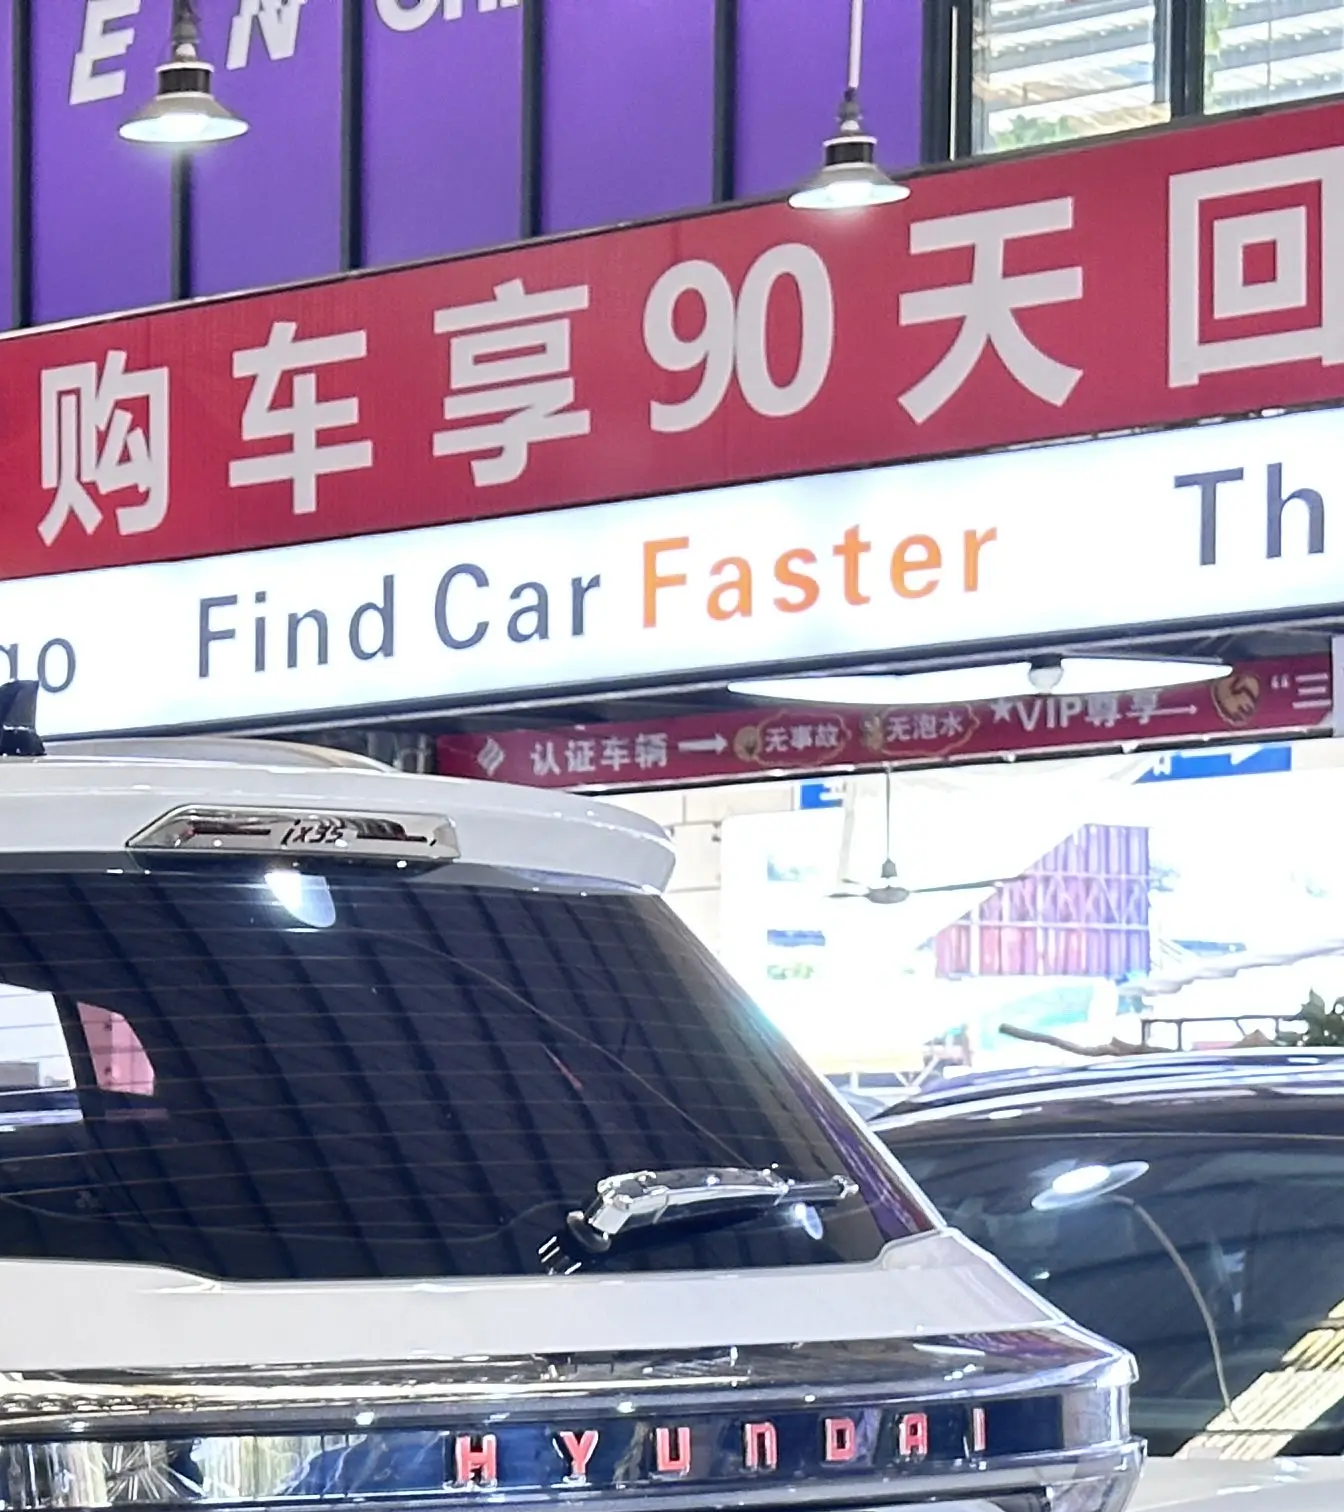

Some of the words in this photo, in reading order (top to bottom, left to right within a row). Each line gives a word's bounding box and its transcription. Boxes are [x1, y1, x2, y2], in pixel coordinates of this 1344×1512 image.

[198, 574, 395, 678] Find
[434, 562, 602, 650] Car
[642, 525, 998, 628] Faster
[1174, 461, 1325, 566] Th
[531, 733, 669, 776] 认证车辆
[764, 726, 840, 753] 无事故
[886, 710, 964, 742] 无泡水
[454, 1407, 987, 1486] HYUNDAI
